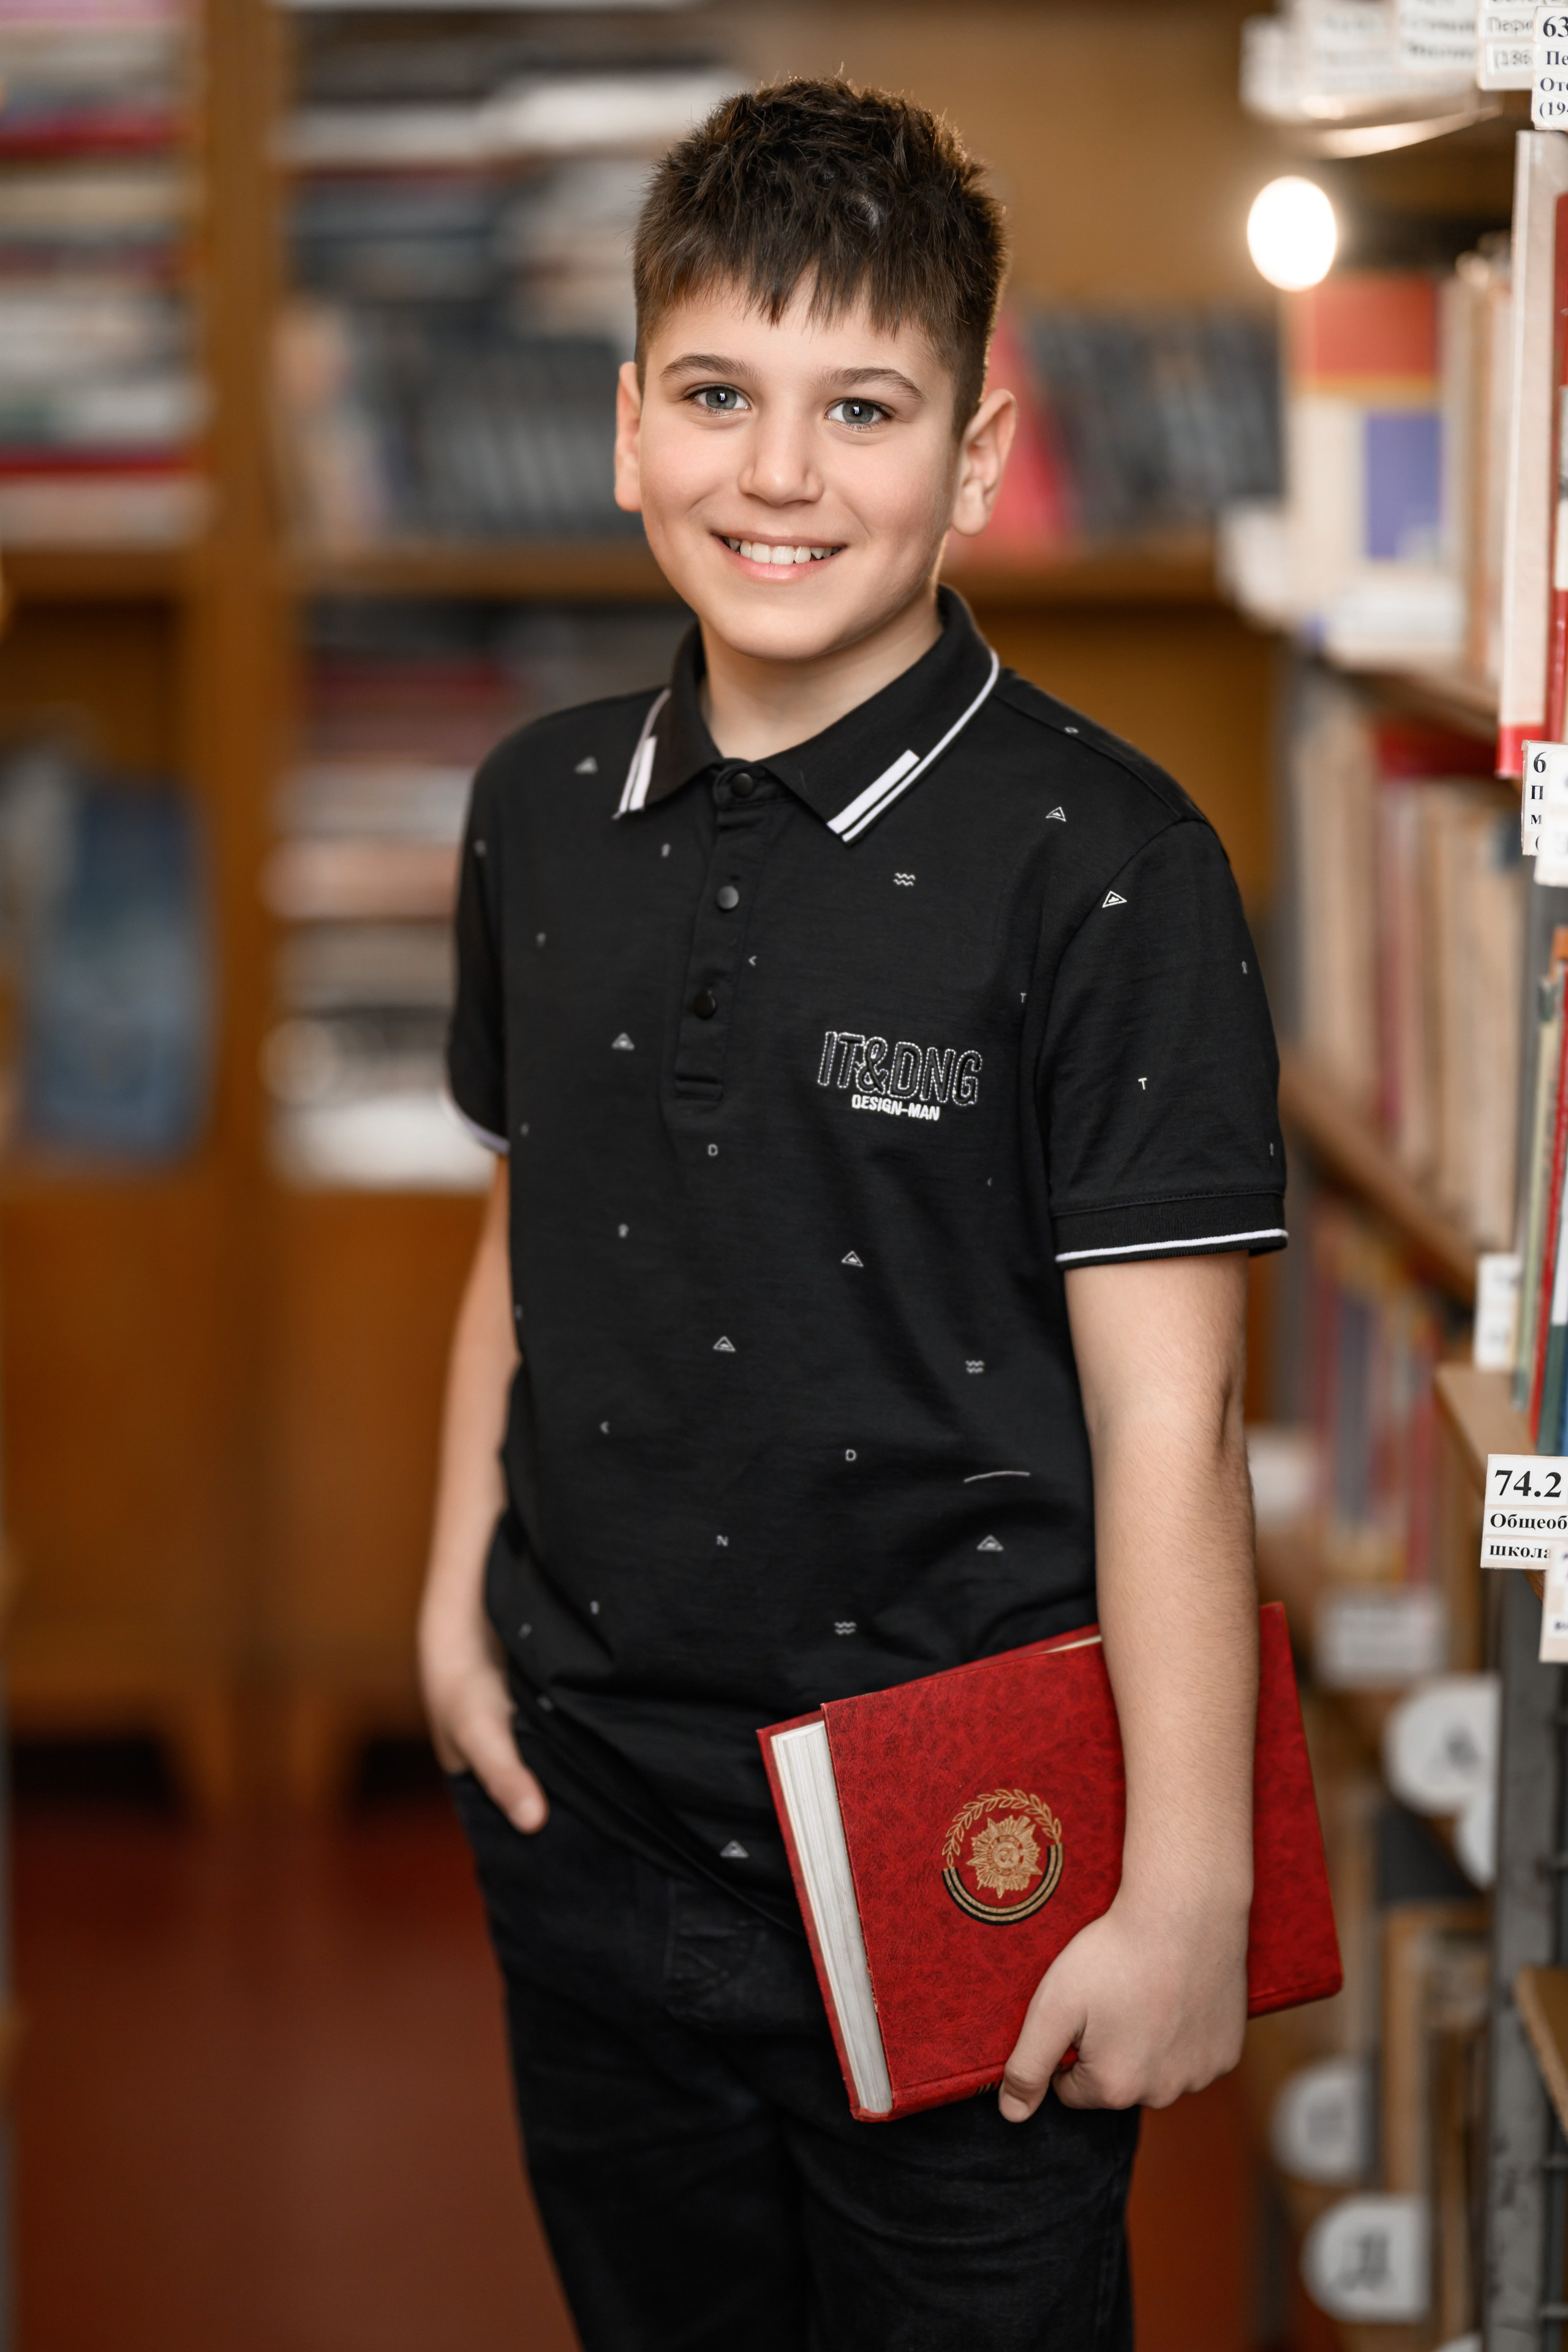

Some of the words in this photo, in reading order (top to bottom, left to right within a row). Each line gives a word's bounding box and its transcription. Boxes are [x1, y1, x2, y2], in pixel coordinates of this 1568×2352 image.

[1540, 77, 1568, 91] От
[1539, 101, 1568, 118] (19
[817, 1030, 983, 1106] IT&DNG
[851, 1094, 941, 1121] DESIGN-MAN
[1494, 1469, 1562, 1498] 74.2
[1490, 1512, 1568, 1531] Общеоб
